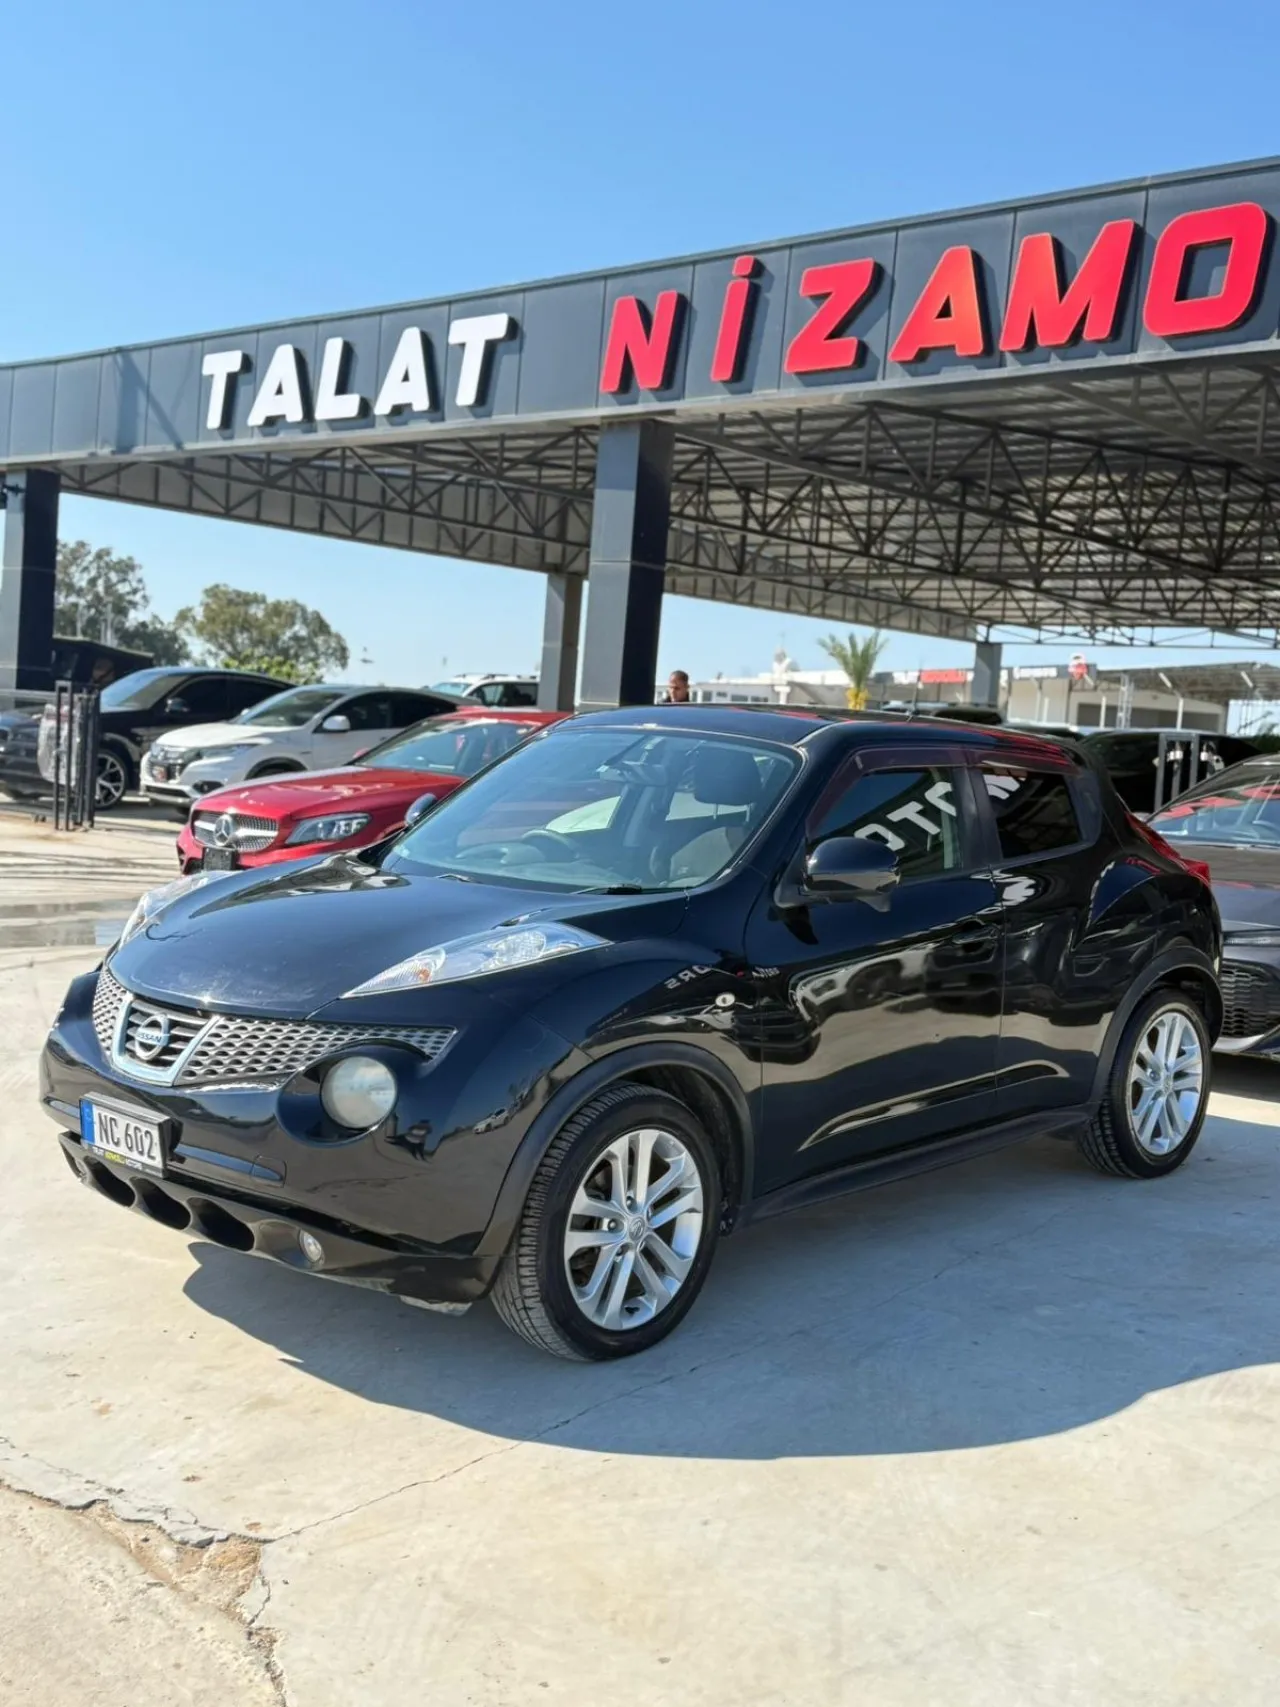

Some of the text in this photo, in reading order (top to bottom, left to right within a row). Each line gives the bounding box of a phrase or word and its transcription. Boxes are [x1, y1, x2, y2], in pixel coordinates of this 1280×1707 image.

[202, 202, 1267, 429] TALAT NİZAMO
[98, 1112, 120, 1147] NC
[125, 1123, 156, 1160] 602
